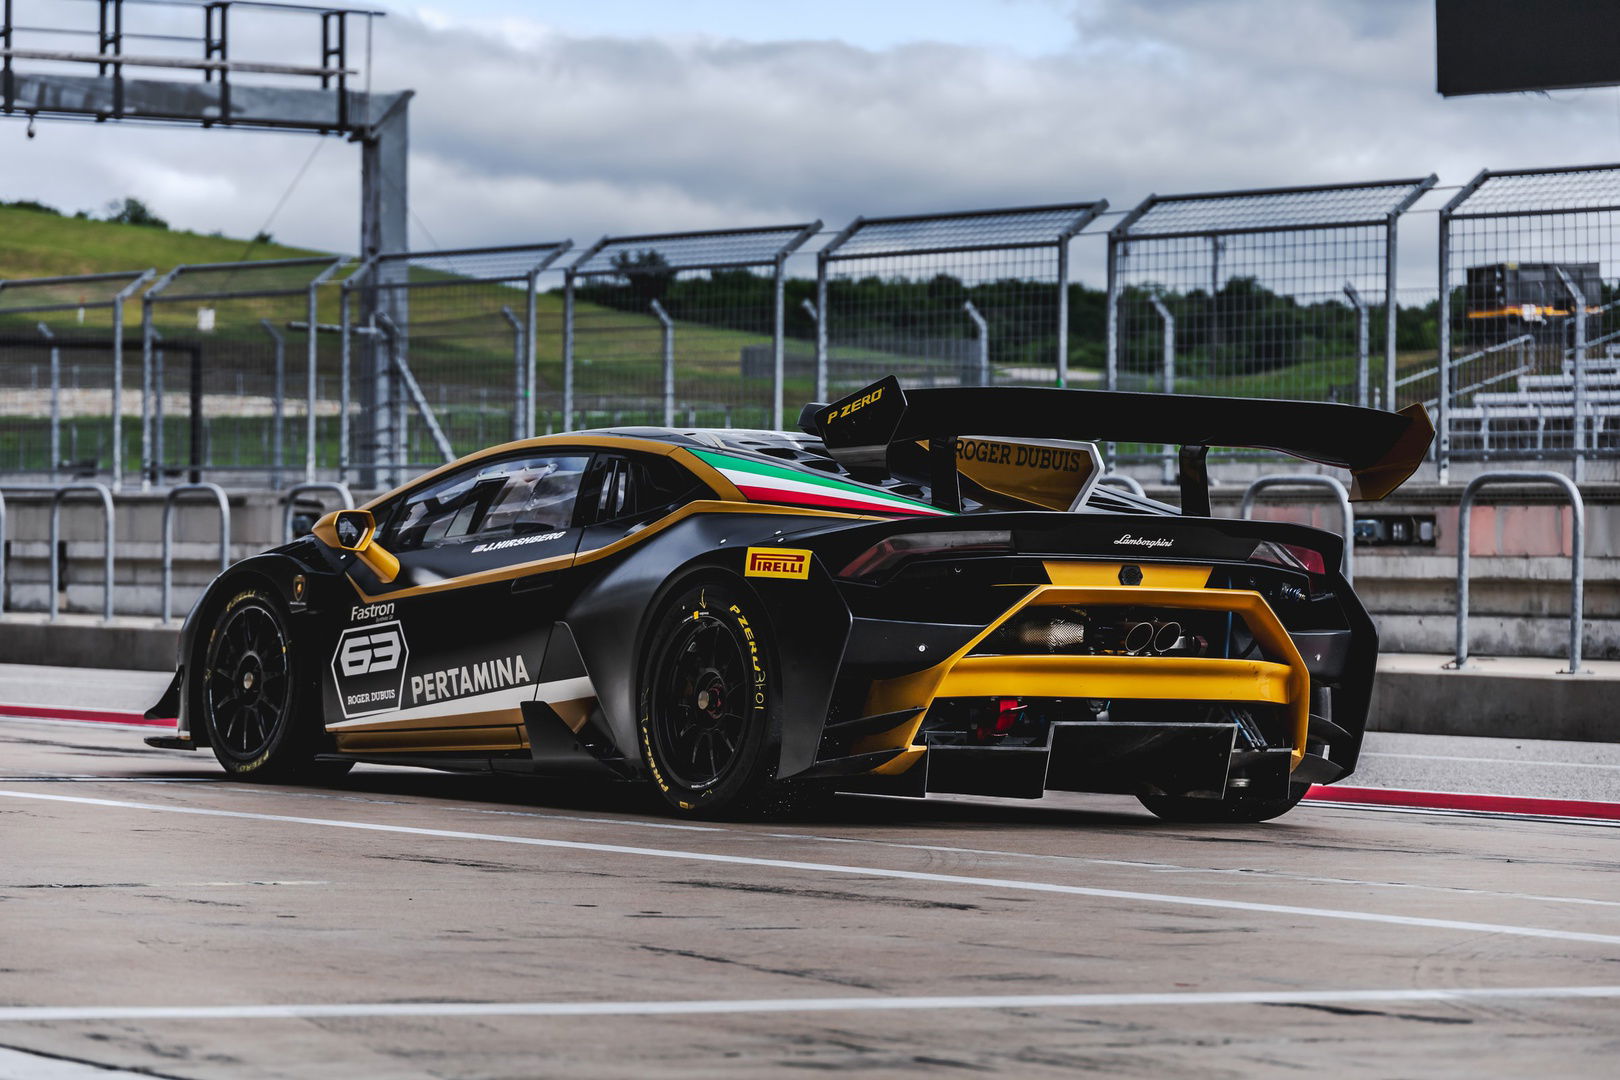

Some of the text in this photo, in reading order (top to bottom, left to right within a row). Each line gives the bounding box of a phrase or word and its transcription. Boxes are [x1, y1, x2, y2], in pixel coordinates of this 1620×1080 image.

[827, 388, 883, 425] P ZERO
[955, 439, 1080, 472] ROGER DUBUIS
[1113, 533, 1174, 549] Lamborghini
[749, 553, 805, 574] PIRELLI
[351, 602, 395, 621] Fastron
[340, 631, 401, 677] 63
[411, 654, 531, 704] PERTAMINA
[347, 689, 396, 705] ROGER DUBUIS
